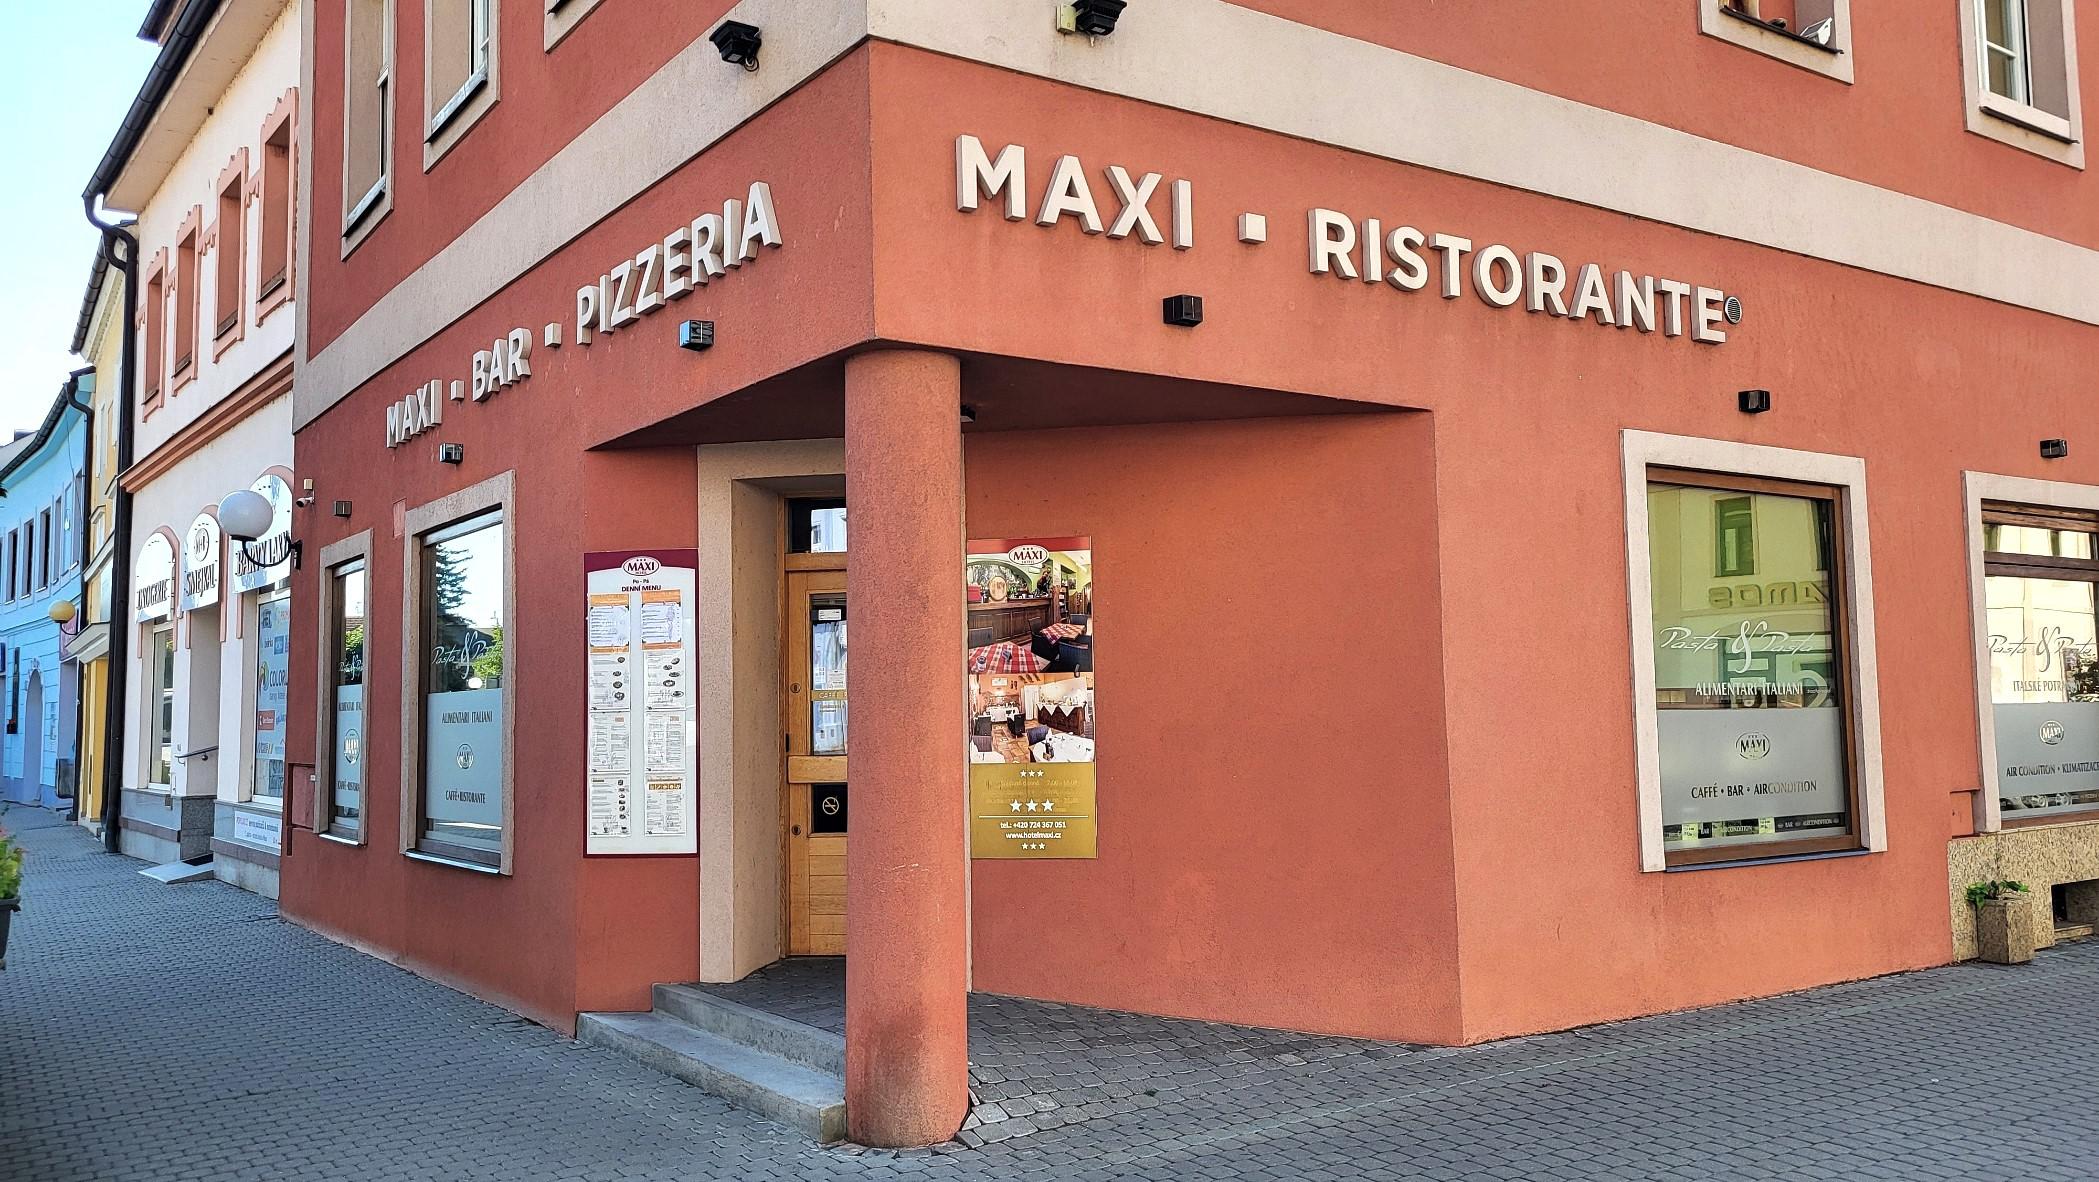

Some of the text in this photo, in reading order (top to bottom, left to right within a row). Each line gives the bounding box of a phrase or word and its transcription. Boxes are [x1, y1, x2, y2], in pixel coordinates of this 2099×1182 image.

[954, 134, 1727, 345] MAXI RISTORANTE
[386, 181, 782, 448] MAXI BAR PIZZERIA
[1013, 550, 1043, 561] MAXI
[627, 562, 655, 572] MAXI
[1660, 621, 1818, 674] Pasta & Pasta
[1988, 635, 2036, 656] Pasta
[432, 644, 461, 667] Pasta
[1696, 682, 1758, 696] ALIMENTARI
[1762, 682, 1803, 696] ITALIANI
[442, 710, 493, 724] ALIMENTARI ITALIANI
[2006, 767, 2018, 777] AIR
[2019, 764, 2056, 777] CONDITION
[1691, 780, 1817, 799] CAFFÉ BAR AIRCONDITION
